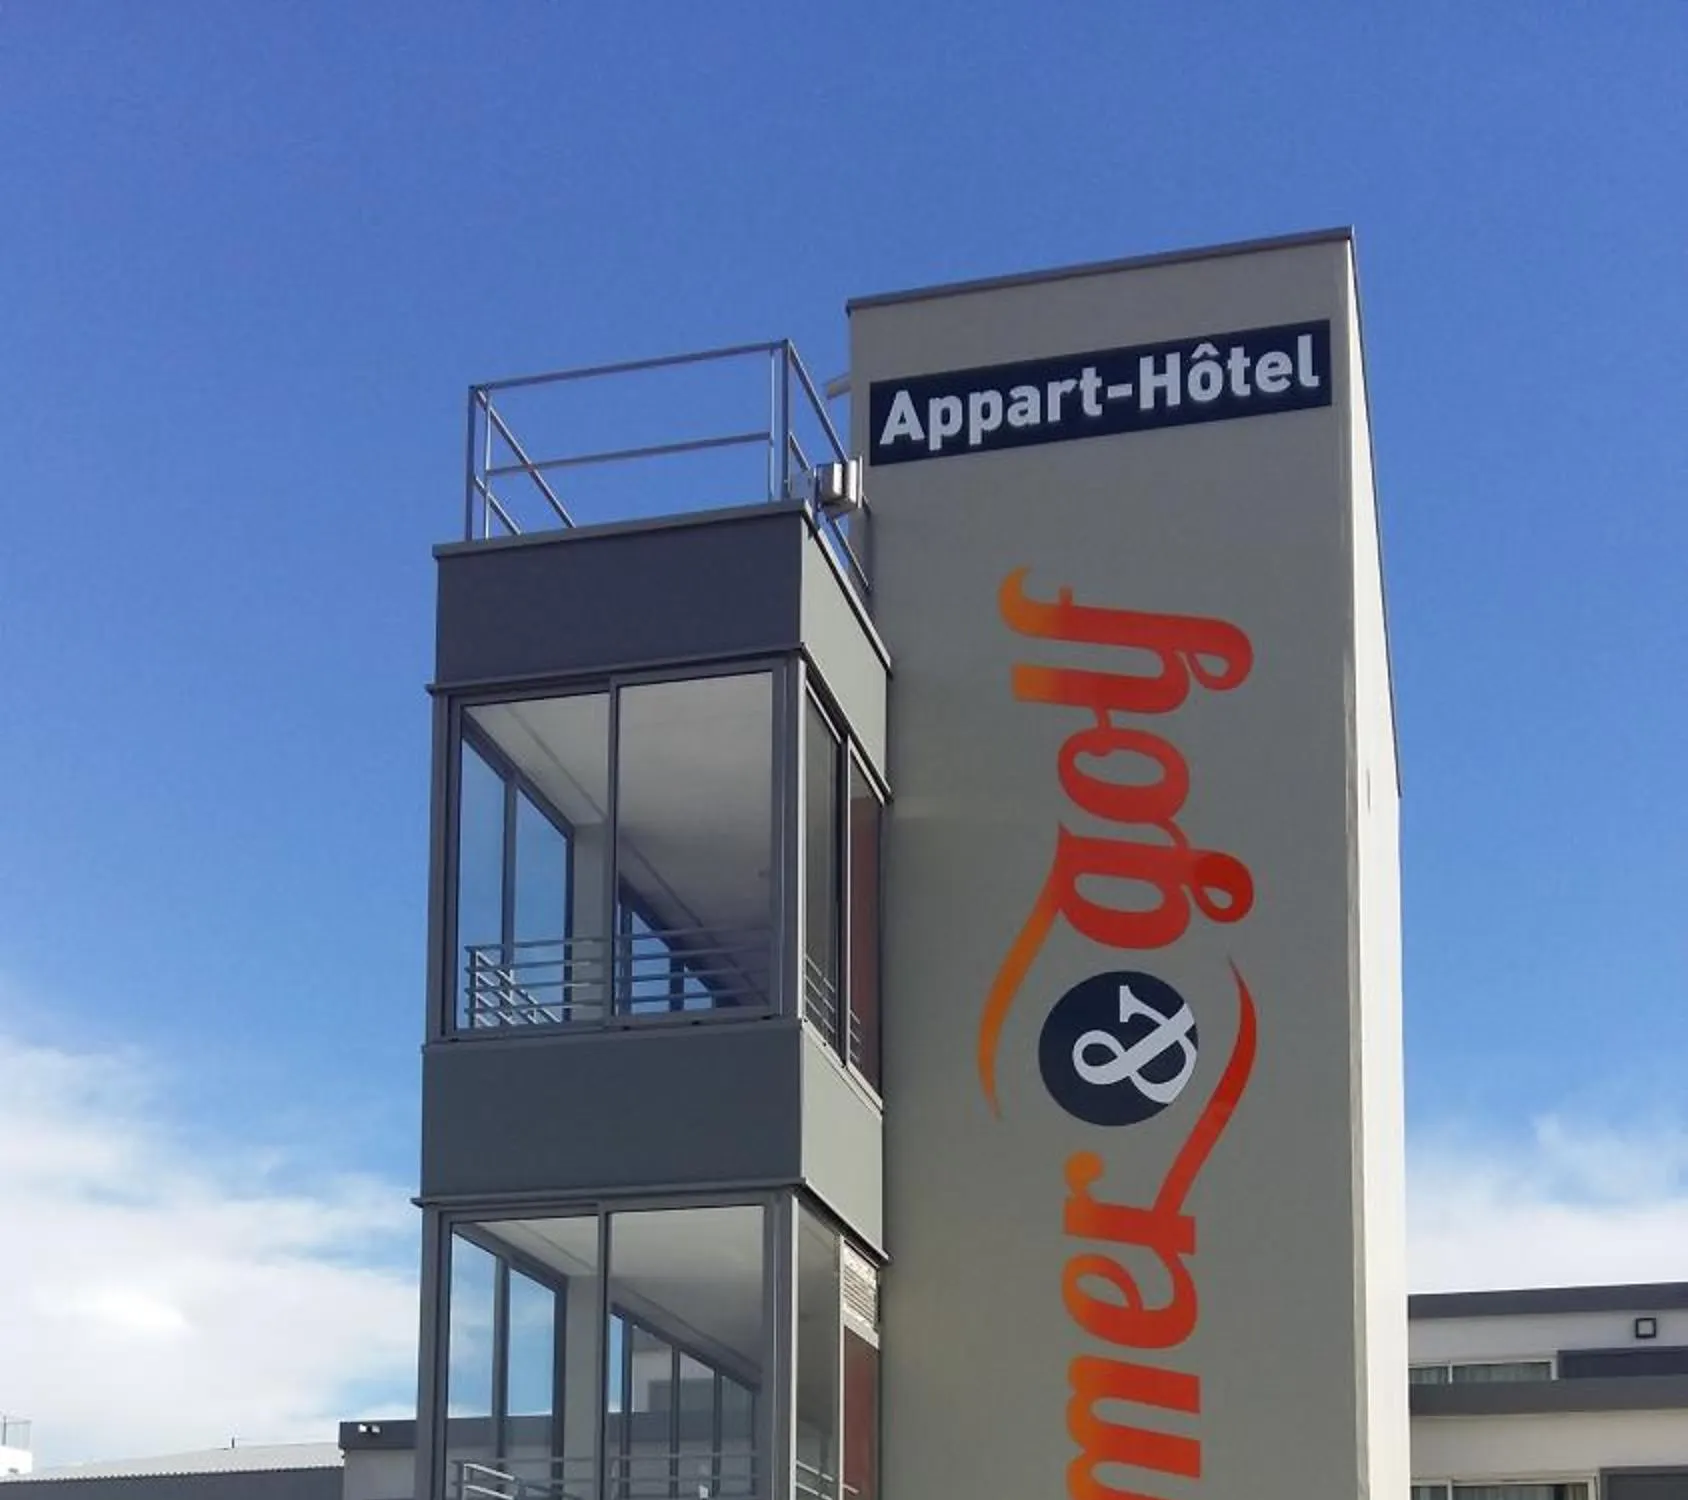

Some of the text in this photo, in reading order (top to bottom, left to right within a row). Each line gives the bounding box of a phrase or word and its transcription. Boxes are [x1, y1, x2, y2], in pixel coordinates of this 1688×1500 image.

[879, 334, 1320, 451] Appart-Hôtel
[977, 566, 1254, 1121] golf
[1072, 985, 1198, 1105] &
